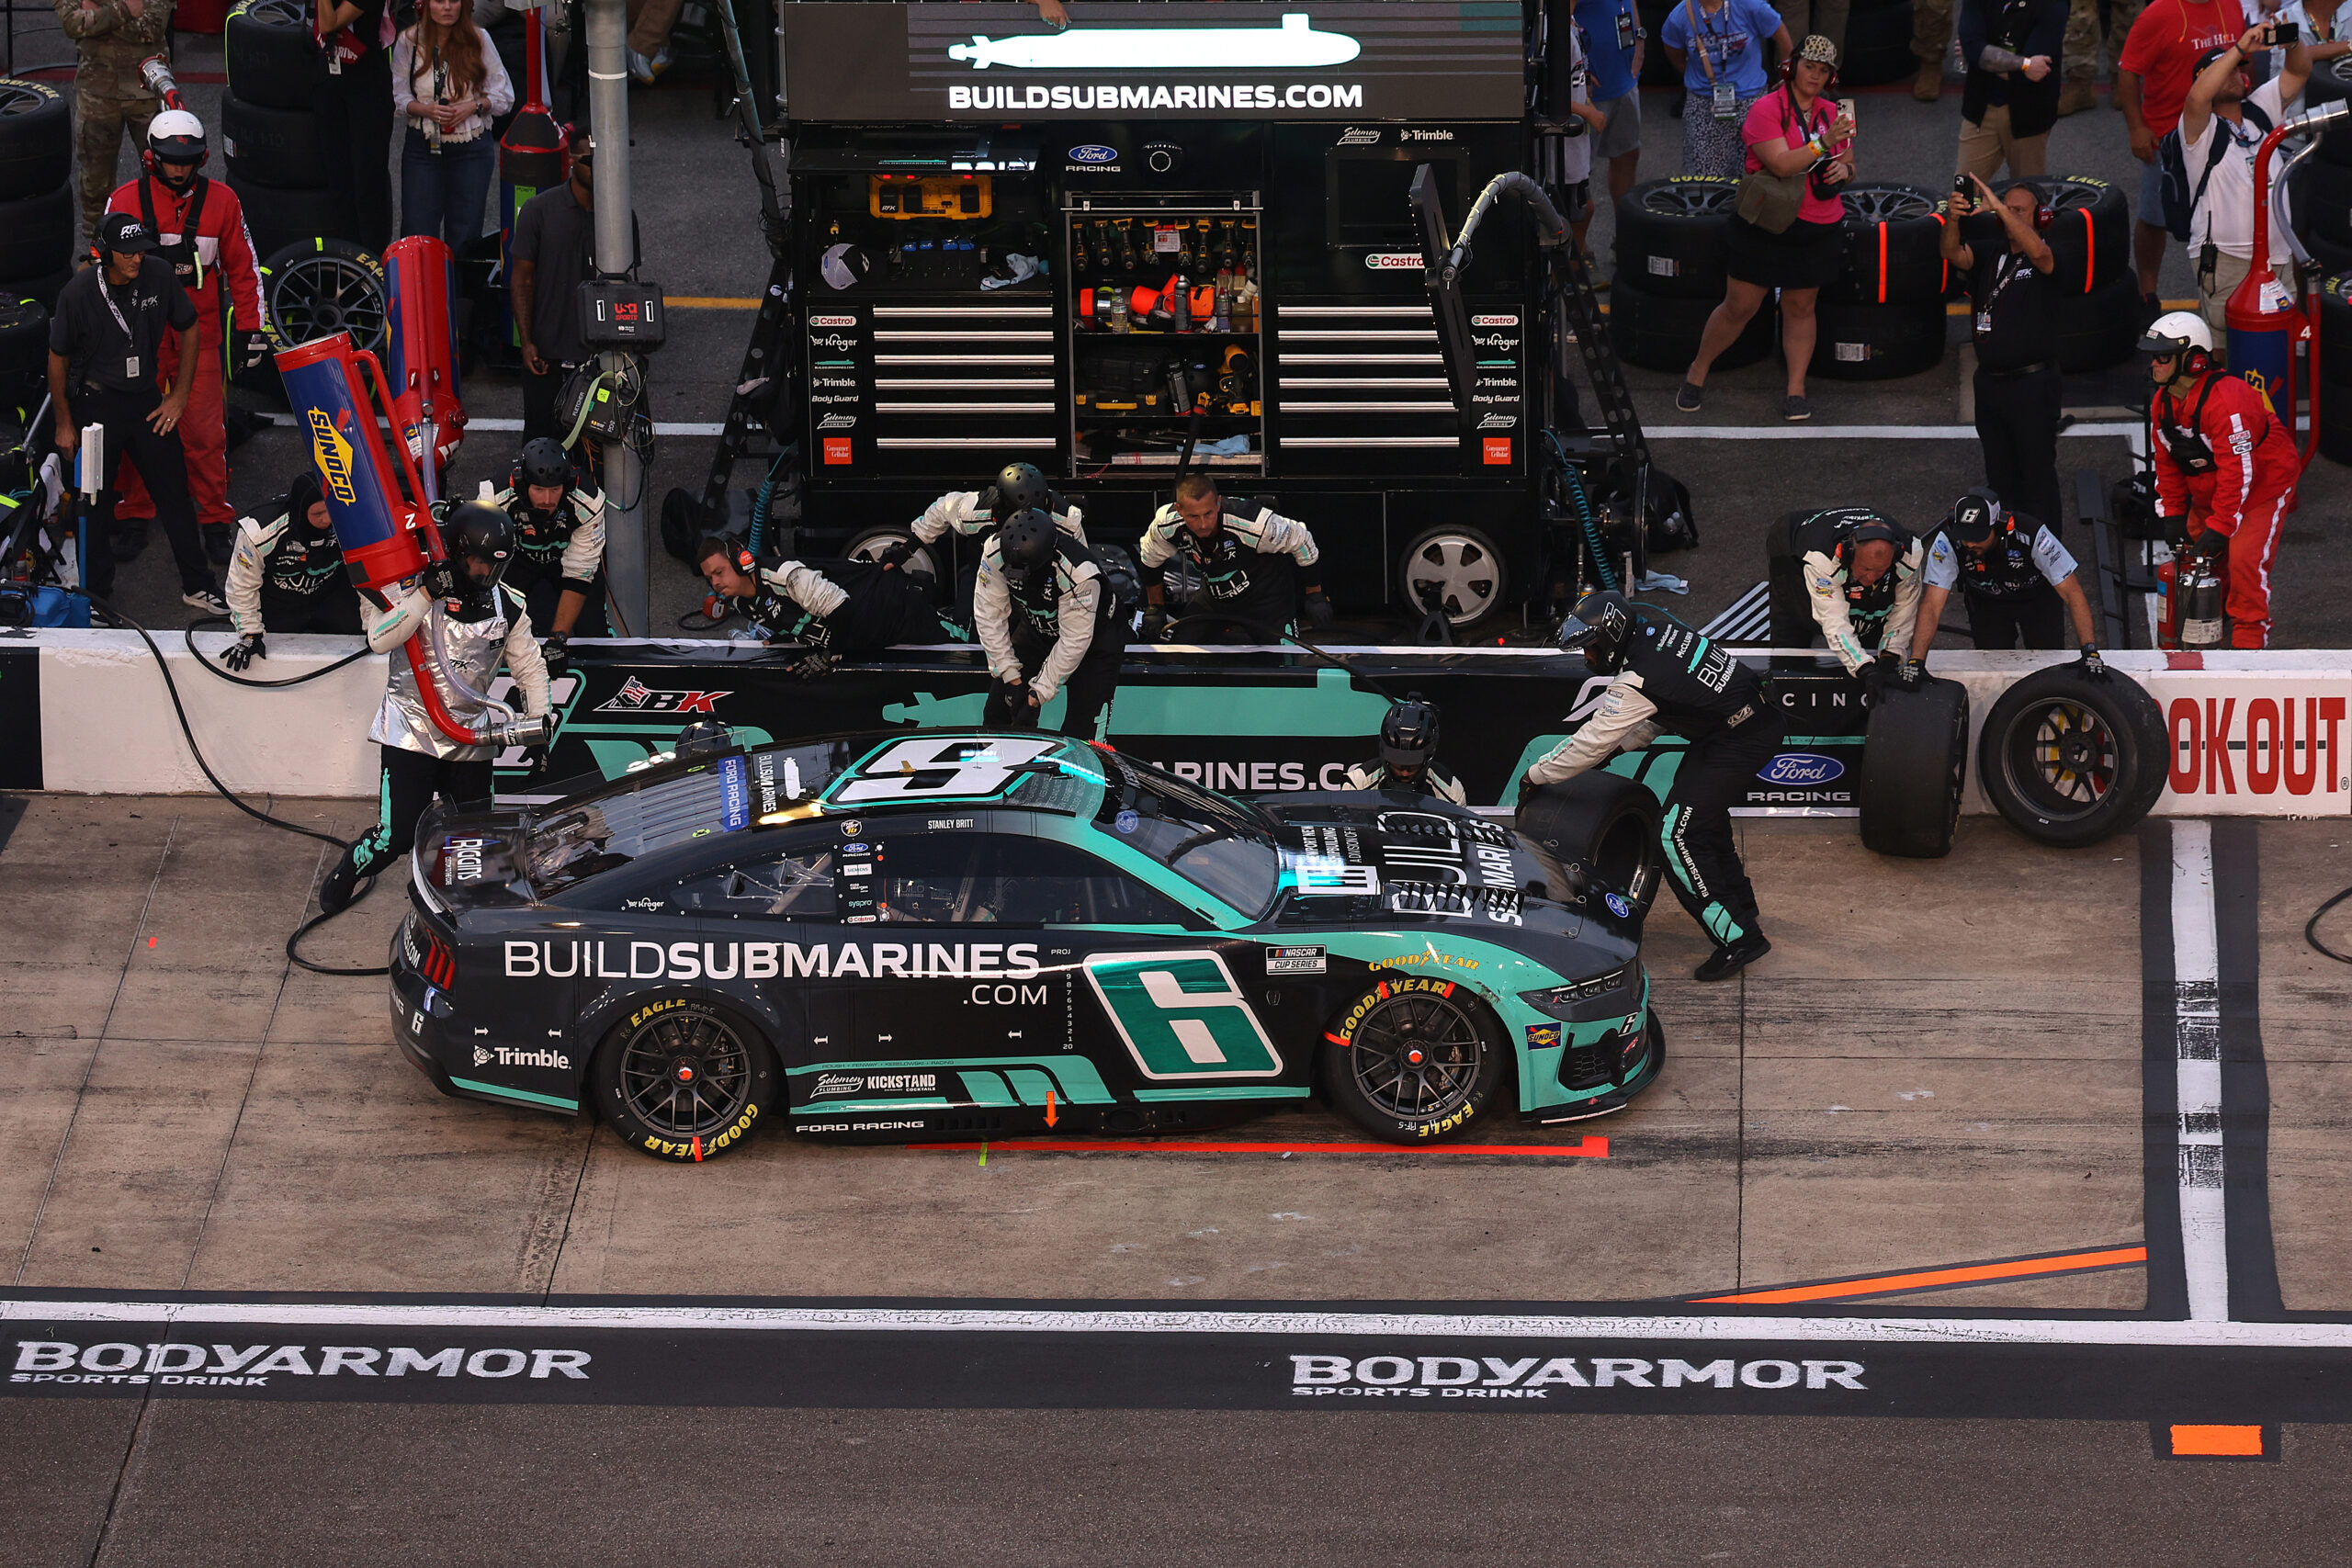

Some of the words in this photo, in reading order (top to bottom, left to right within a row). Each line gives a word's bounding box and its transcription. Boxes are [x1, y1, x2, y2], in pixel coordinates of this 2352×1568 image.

[949, 85, 1363, 109] BUILDSUBMARINES.COM
[1411, 130, 1453, 141] Trimble
[1077, 147, 1108, 161] Ford
[120, 222, 142, 235] RFK
[1381, 255, 1425, 266] Castro
[820, 317, 853, 325] Castrol
[2301, 325, 2312, 338] 4
[825, 333, 857, 351] Kroger
[1487, 333, 1519, 351] Kroger
[821, 378, 856, 387] Trimble
[1483, 378, 1517, 387] Trimble
[572, 391, 585, 417] FLETCHER
[812, 395, 832, 404] Body
[1472, 395, 1494, 404] Body
[309, 411, 356, 502] SUNOCO
[405, 513, 416, 529] 2
[1961, 508, 1980, 524] 6
[2246, 697, 2346, 795] OUT
[724, 759, 737, 784] FORD
[1770, 758, 1827, 780] Ford
[1747, 791, 1850, 802] RACING
[727, 784, 741, 827] RACING
[927, 818, 955, 829] STANLEY
[956, 818, 974, 829] BRITT
[443, 838, 483, 881] RIGGINS
[639, 897, 664, 911] Kroger
[848, 899, 873, 908] syspro
[1284, 947, 1317, 956] NASCAR
[504, 940, 1039, 981] BUILDSUBMARINES
[1274, 960, 1291, 969] CUP
[1291, 959, 1317, 968] SERIES
[1368, 948, 1480, 972] GOODYEAR
[963, 984, 1047, 1005] .COM
[630, 998, 686, 1028] EAGLE
[1082, 949, 1284, 1080] 6
[1340, 977, 1447, 1041] GOODYEAR
[412, 1010, 425, 1036] 6
[1527, 1031, 1560, 1042] SUNOCO
[494, 1047, 570, 1069] Trimble
[867, 1074, 936, 1089] KICKSTAND
[796, 1123, 849, 1133] FORD
[853, 1121, 924, 1132] RACING
[1418, 1102, 1475, 1138] EAGLE
[644, 1103, 759, 1157] GOODYEAR
[16, 1340, 592, 1380] BODYARMOR
[11, 1373, 150, 1385] SPORTS
[160, 1373, 270, 1387] DRINK
[1289, 1354, 1869, 1390] BODYARMOR
[1292, 1386, 1430, 1397] SPORTS
[1442, 1388, 1549, 1398] DRINK
